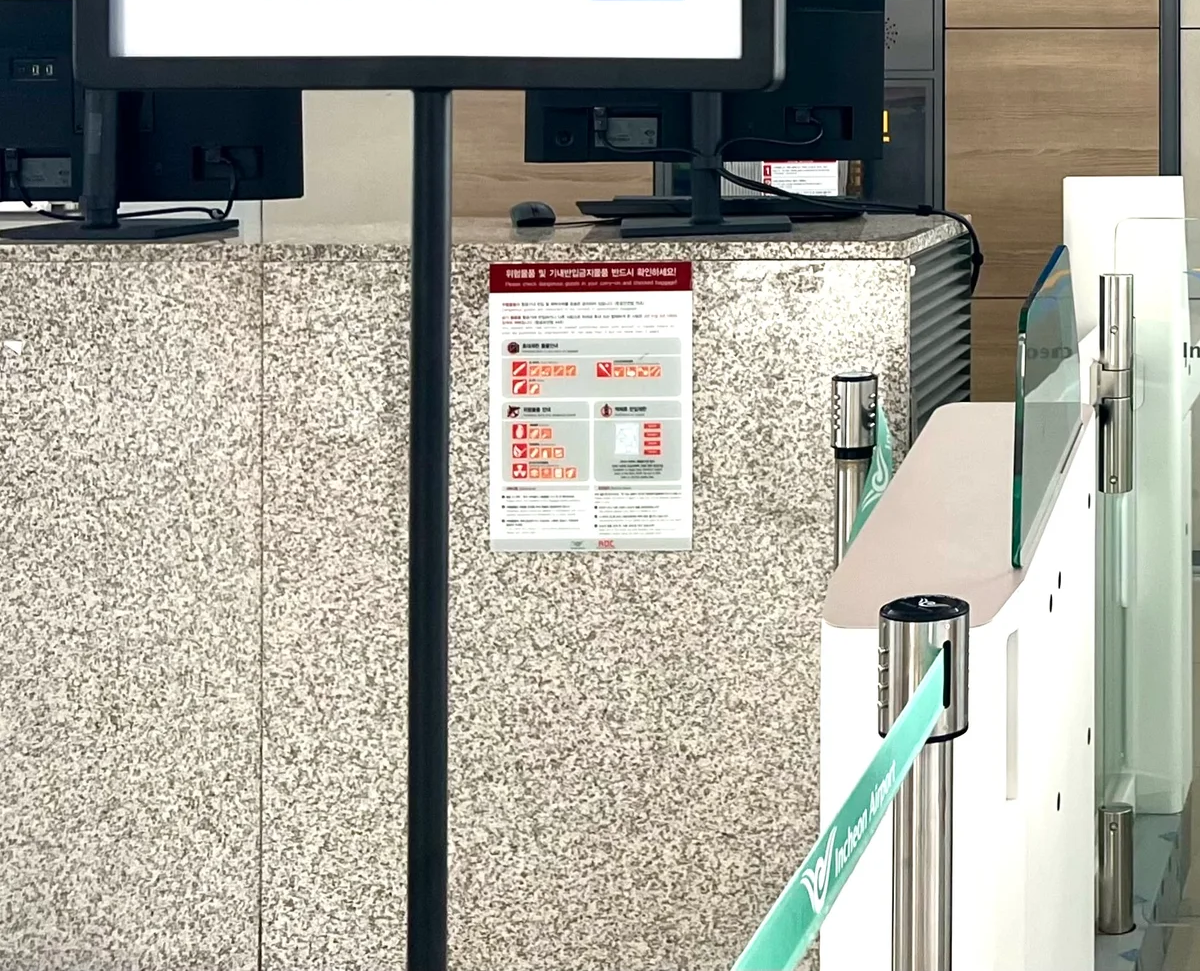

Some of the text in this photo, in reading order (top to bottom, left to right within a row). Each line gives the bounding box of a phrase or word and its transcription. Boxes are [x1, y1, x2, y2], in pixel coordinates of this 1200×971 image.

[611, 268, 634, 278] 반드시
[637, 267, 676, 277] 확인하세요!
[835, 759, 896, 878] Incheon Airport
